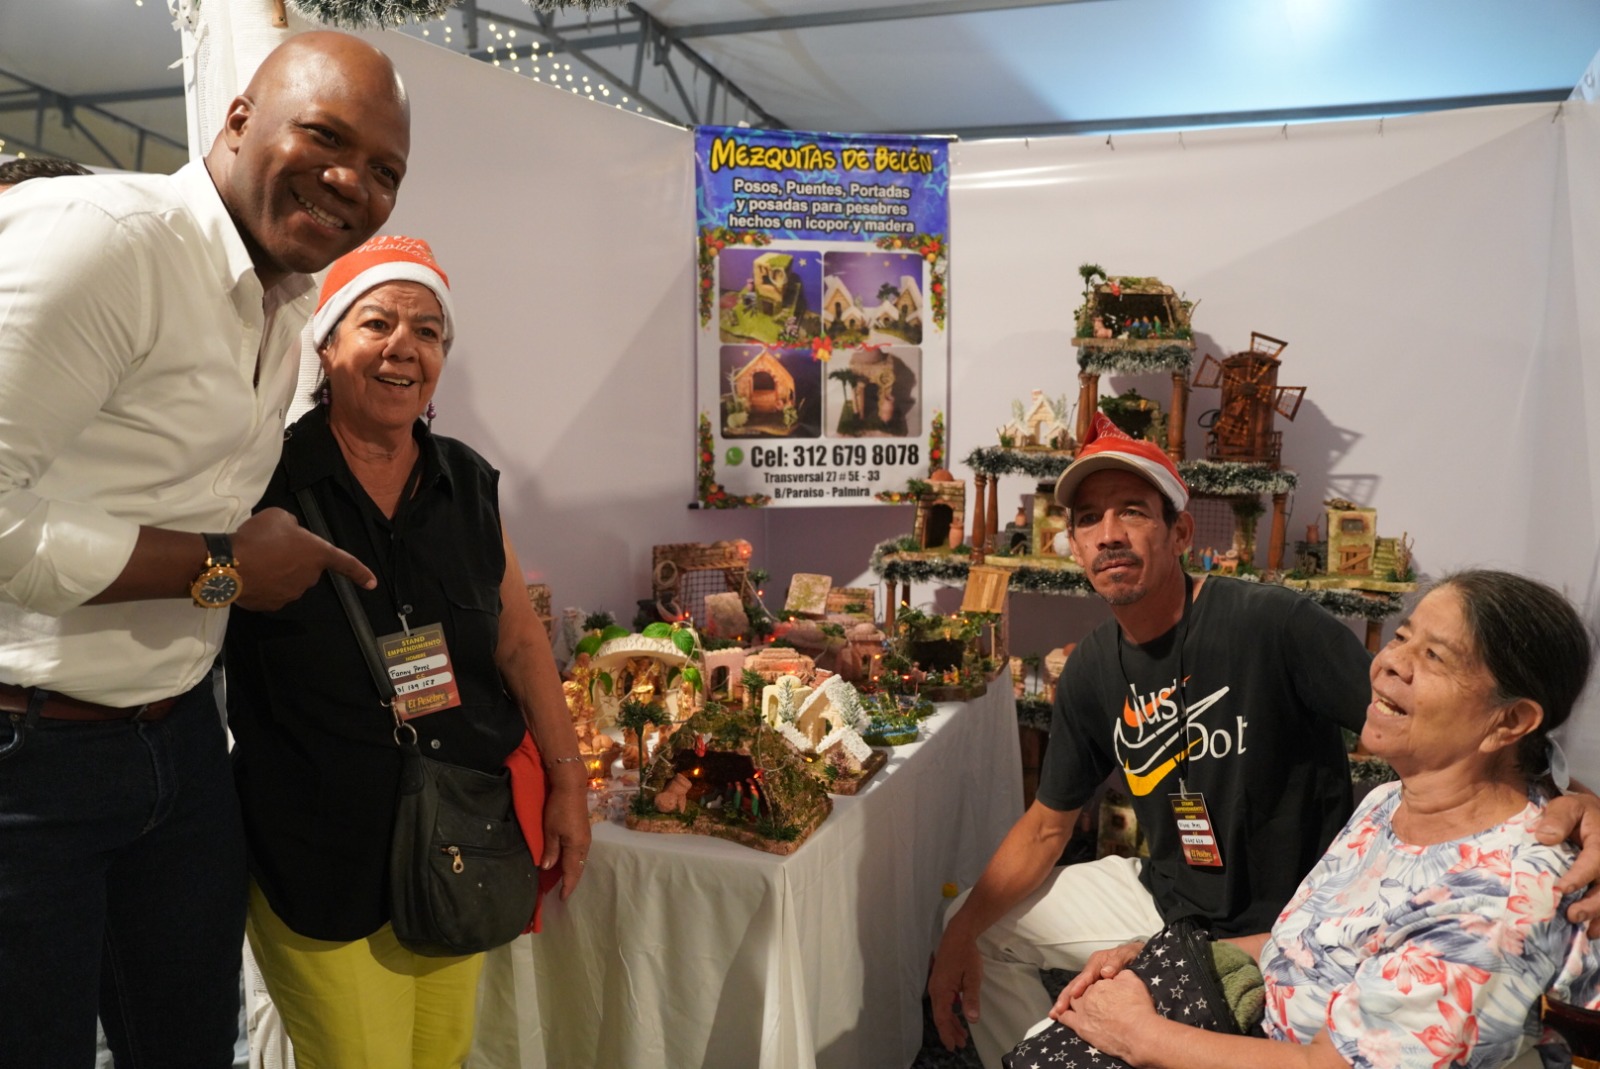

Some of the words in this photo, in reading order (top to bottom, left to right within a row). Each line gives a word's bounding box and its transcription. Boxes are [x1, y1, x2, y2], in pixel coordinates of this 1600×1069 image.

[710, 137, 837, 171] MEZQUITAS
[842, 149, 871, 171] DE
[734, 178, 782, 195] Posos,
[786, 180, 847, 197] Puentes,
[851, 183, 911, 198] Portadas
[736, 200, 744, 213] y
[749, 197, 808, 213] posadas
[812, 201, 842, 214] para
[846, 201, 908, 215] pesebres
[729, 214, 781, 228] hechos
[784, 218, 802, 228] en
[805, 216, 849, 232] icopor
[852, 220, 860, 233] y
[865, 218, 914, 232] madera
[751, 446, 788, 467] Cel:
[793, 445, 827, 467] 312
[832, 444, 866, 466] 679
[872, 443, 919, 465] 8078
[764, 471, 824, 483] Transversal
[826, 471, 837, 482] 27
[839, 472, 847, 482] #
[848, 470, 860, 481] 5E
[867, 470, 881, 481] 33
[774, 487, 824, 499] B/Paraiso
[832, 486, 870, 498] Palmira
[388, 639, 441, 657] EMPRENDIMIENTO
[402, 636, 425, 646] STAND
